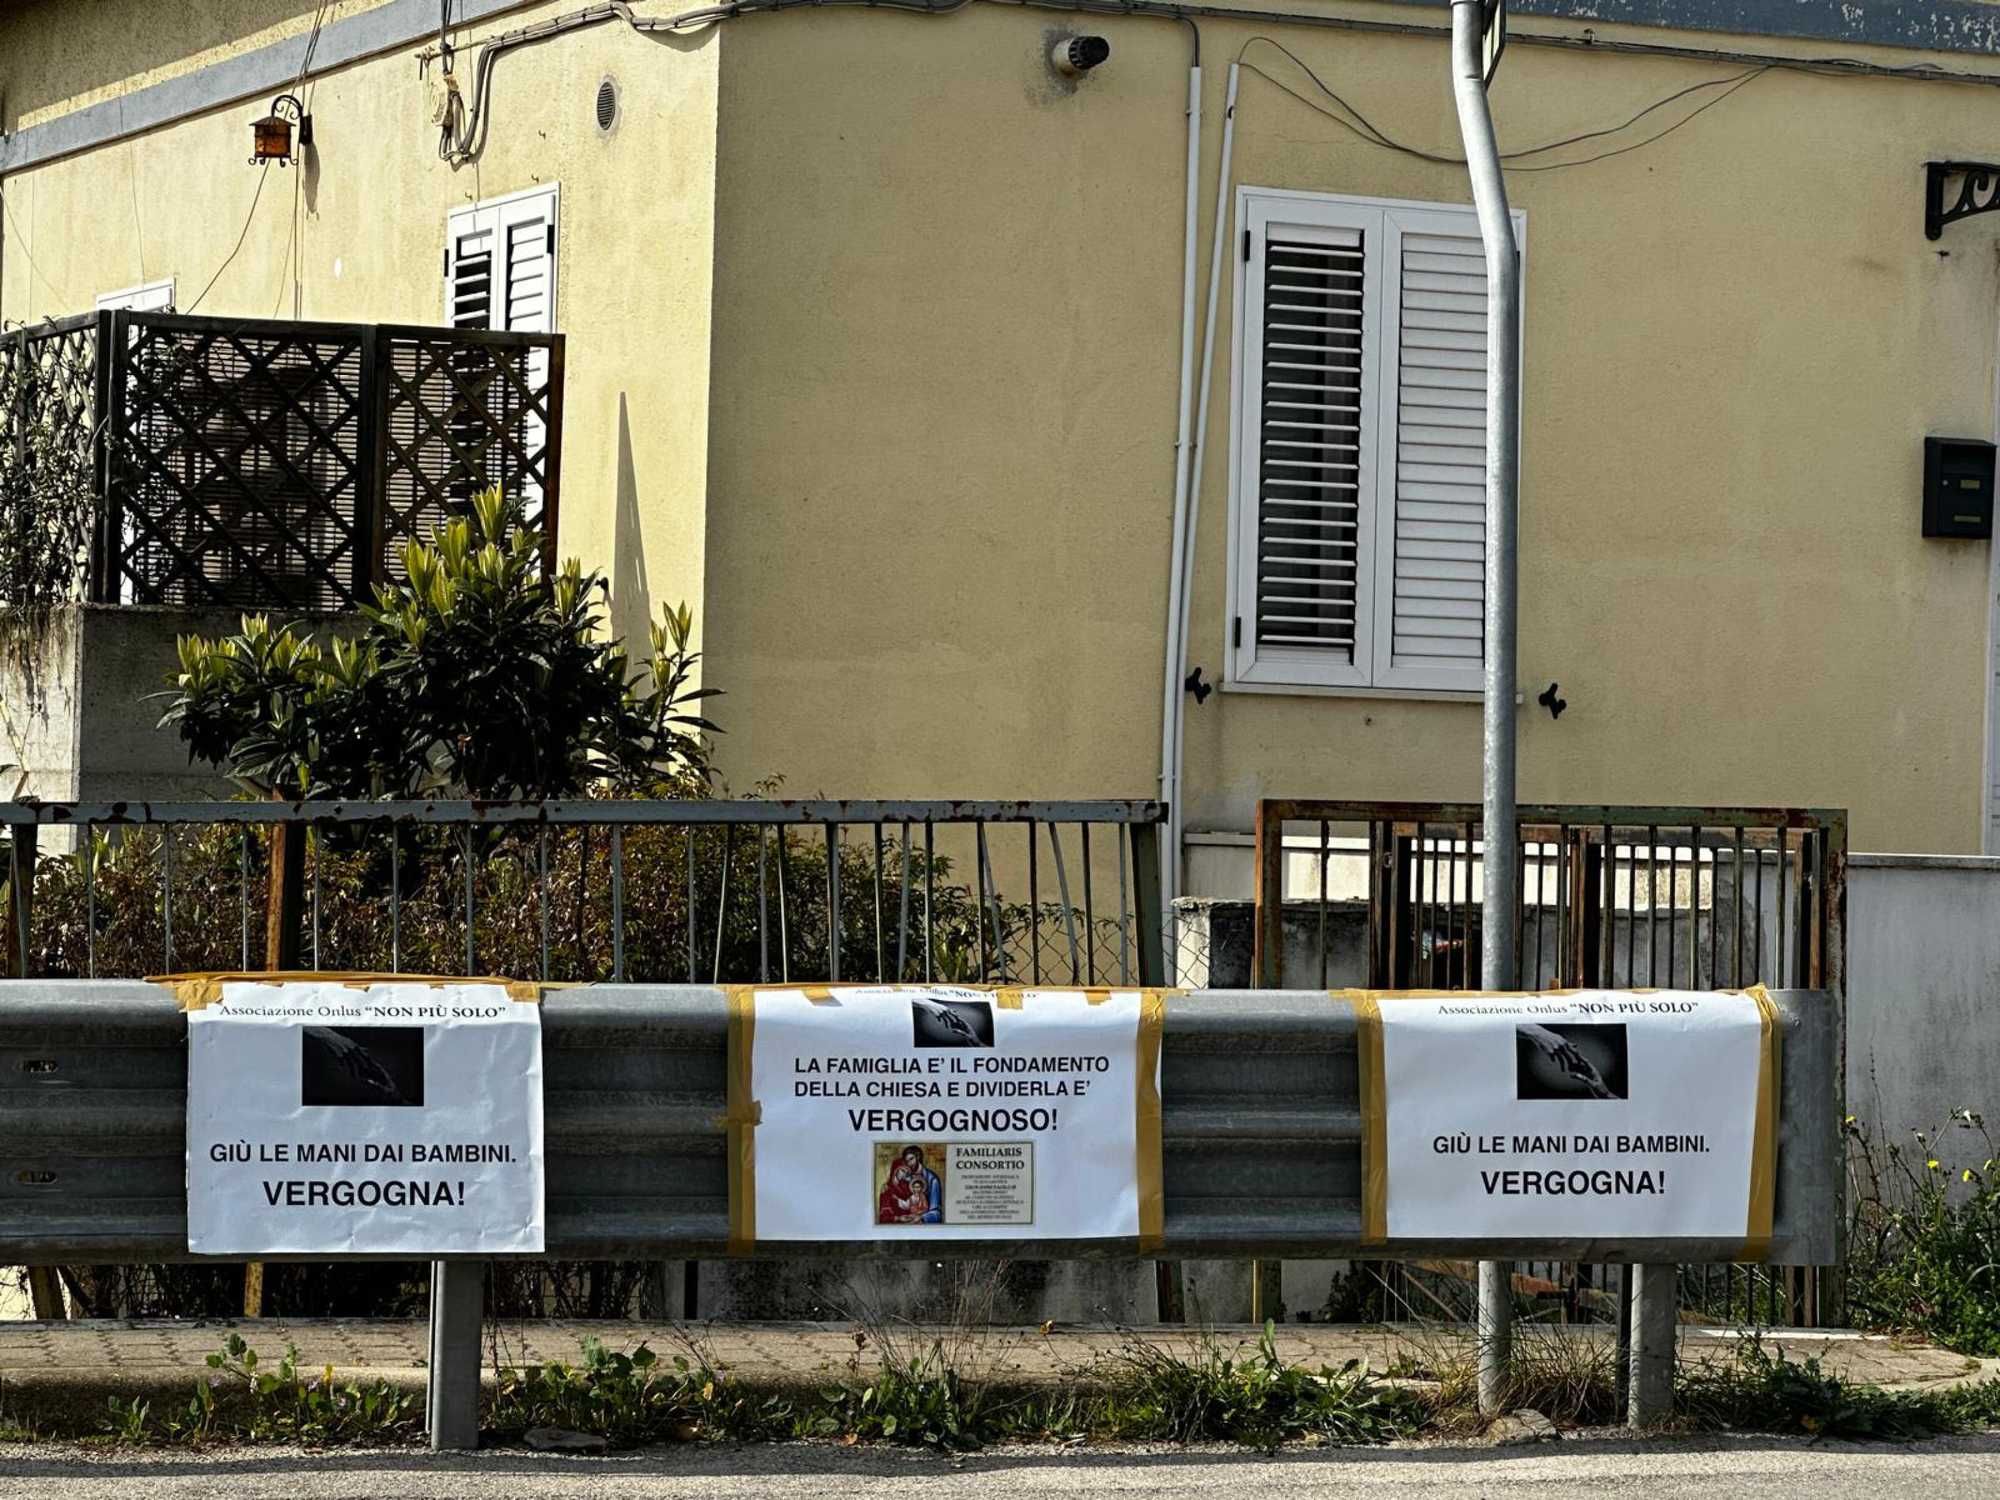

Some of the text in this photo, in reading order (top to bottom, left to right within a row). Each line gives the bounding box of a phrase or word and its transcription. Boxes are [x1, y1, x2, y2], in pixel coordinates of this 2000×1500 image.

[220, 1004, 506, 1018] Associazione Onlus “NON PIÙ SOLO”
[1438, 1001, 1699, 1015] Associazione Onlus “NON PIÙ SOLO”
[795, 1058, 821, 1073] LA
[827, 1058, 922, 1074] FAMIGLIA
[951, 1058, 968, 1073] IL
[974, 1056, 1110, 1073] FONDAMENTO
[795, 1081, 860, 1097] DELLA
[866, 1081, 941, 1098] CHIESA
[948, 1082, 960, 1097] E
[966, 1080, 1069, 1097] DIVIDERLA
[848, 1109, 1058, 1132] VERGOGNOSO!
[210, 1139, 517, 1163] GIÙ LE MANI DAI BAMBINI.
[956, 1147, 1023, 1157] FAMILIARIS
[1433, 1133, 1710, 1154] GIÙ LE MANI DAI BAMBINI.
[956, 1160, 1025, 1170] CONSORTIO
[1481, 1171, 1665, 1196] VERGOGNA!
[263, 1180, 465, 1207] VERGOGNA!
